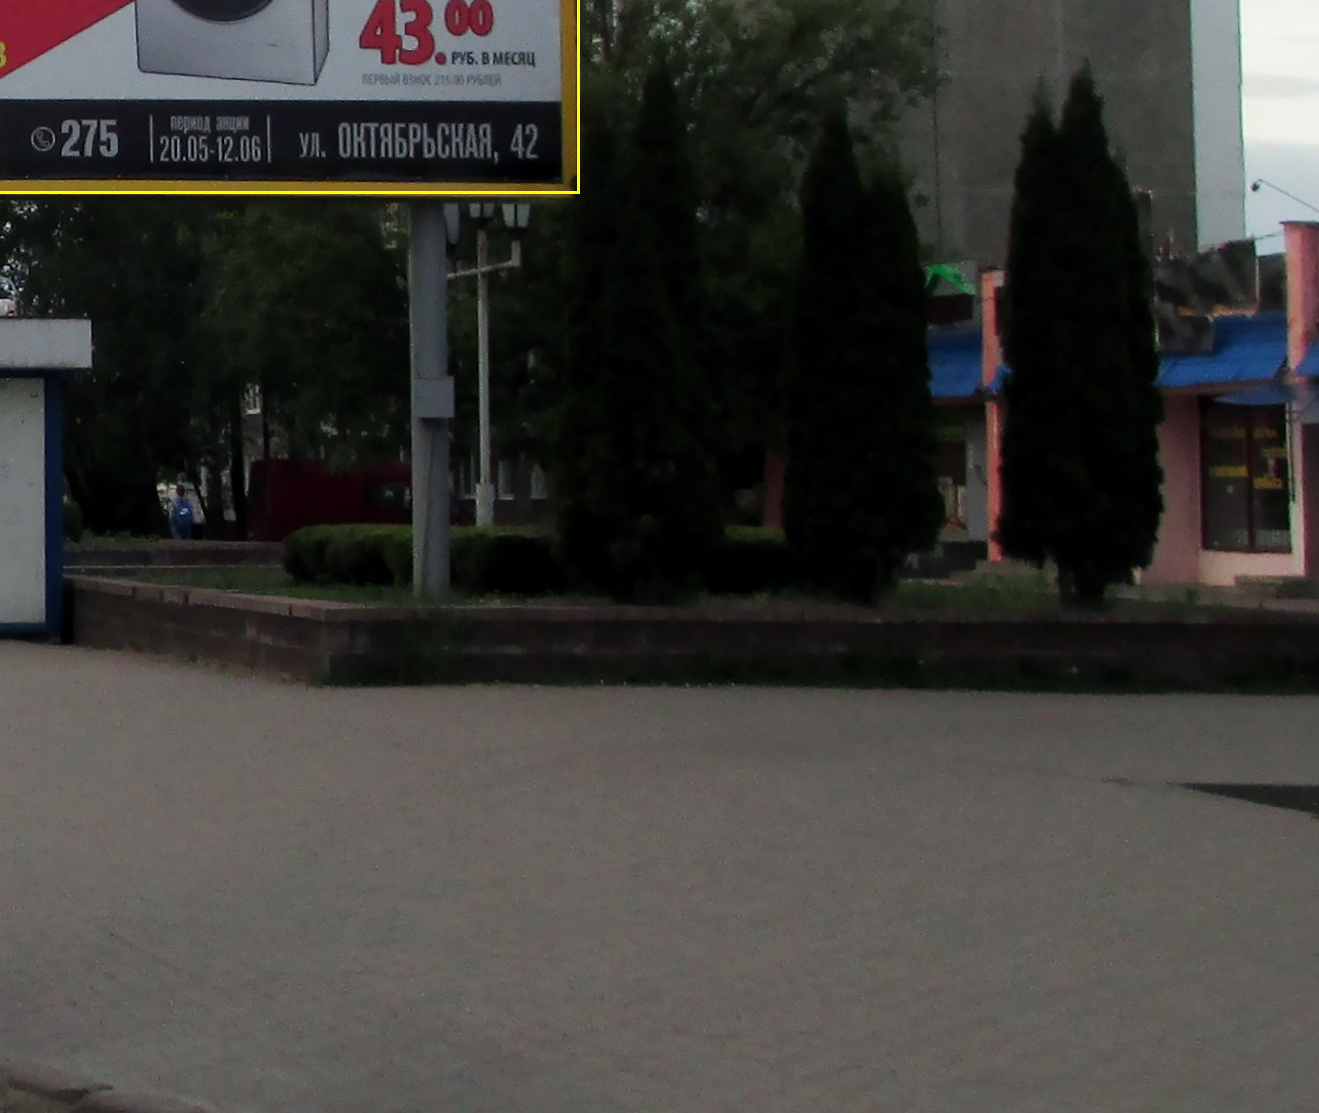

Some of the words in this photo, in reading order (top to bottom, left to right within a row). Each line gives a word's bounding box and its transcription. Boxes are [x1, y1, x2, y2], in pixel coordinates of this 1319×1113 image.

[451, 51, 478, 65] РУБ.
[481, 52, 490, 64] В
[492, 51, 536, 67] МЕСЯЦ
[170, 115, 211, 133] период
[216, 116, 250, 133] акции
[61, 119, 119, 158] 275
[160, 135, 262, 163] 20.05-12.06
[299, 132, 327, 158] ул.
[338, 122, 499, 164] ОКТЯБРЬСКАЯ,
[510, 124, 539, 159] 42
